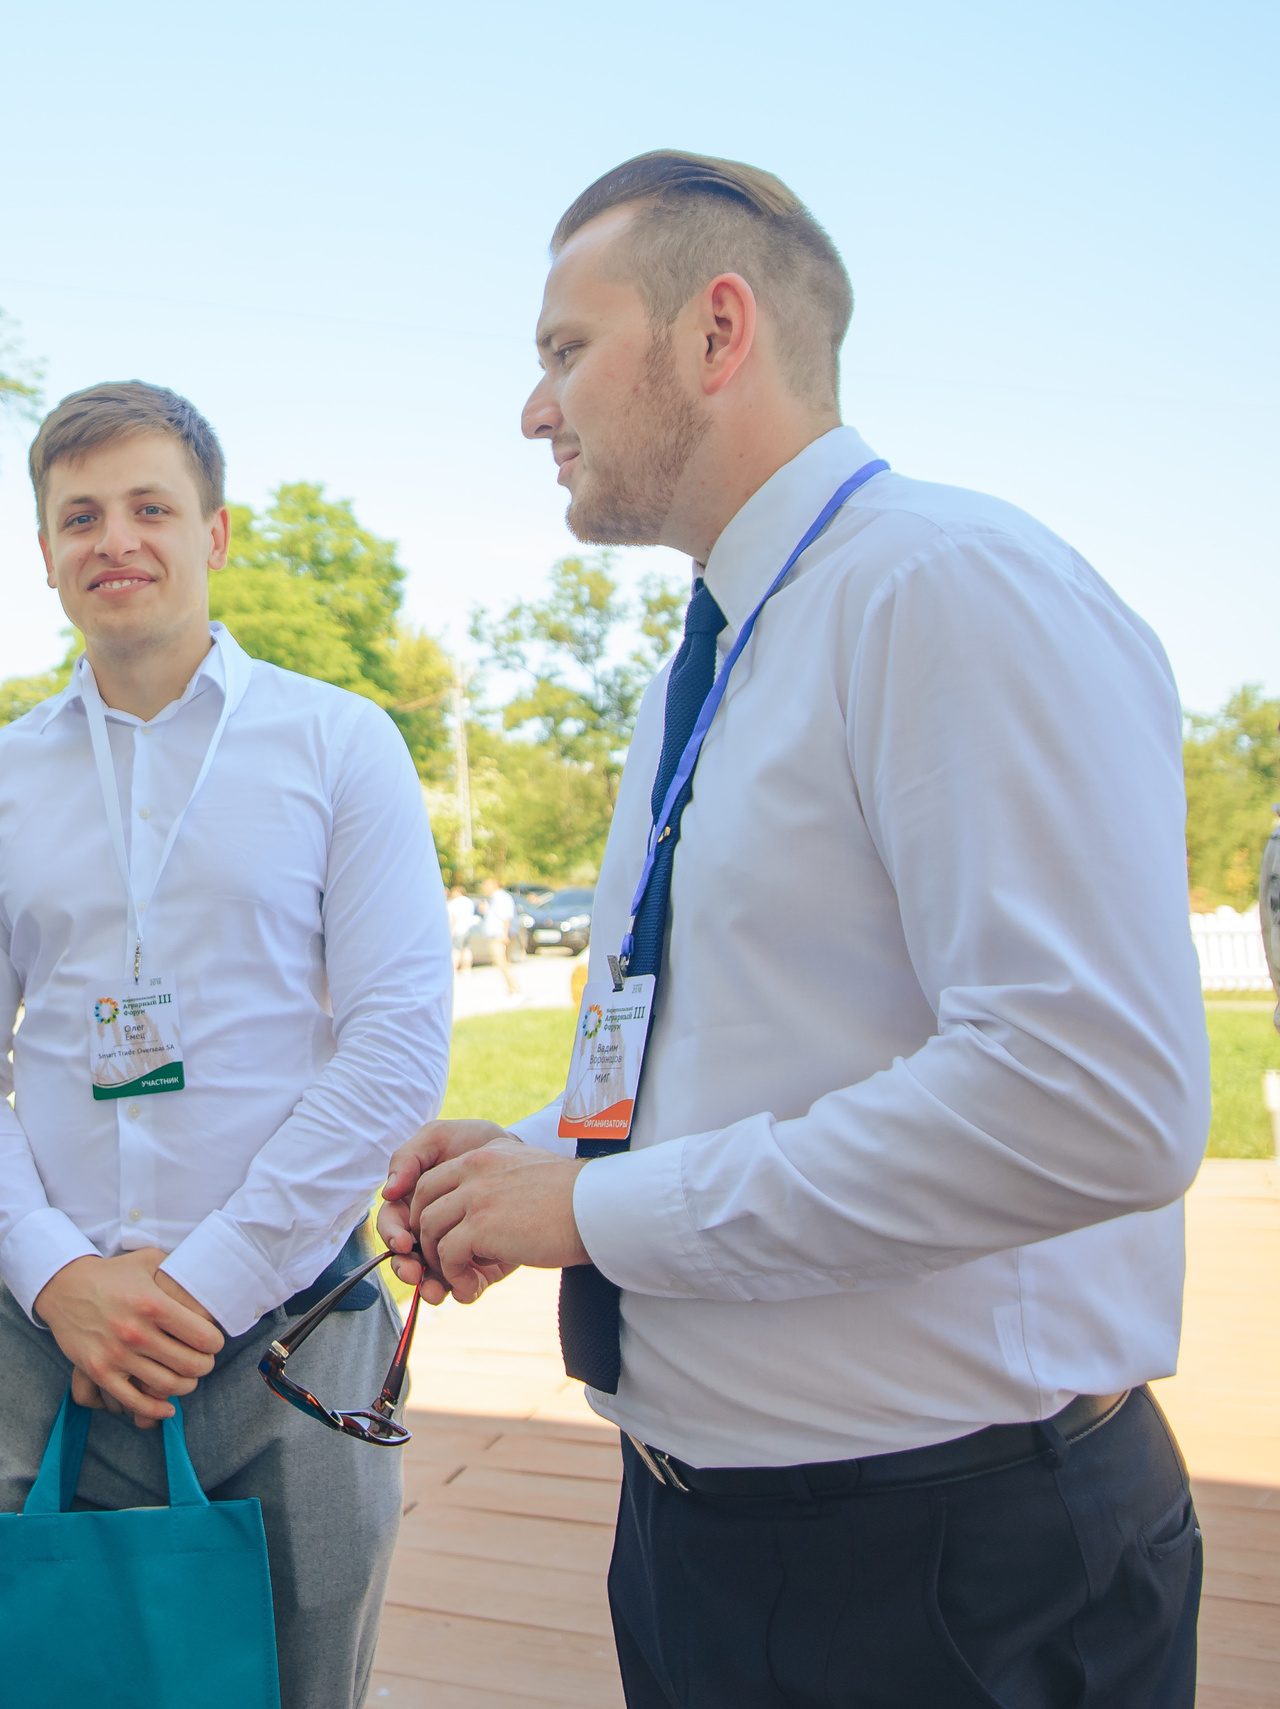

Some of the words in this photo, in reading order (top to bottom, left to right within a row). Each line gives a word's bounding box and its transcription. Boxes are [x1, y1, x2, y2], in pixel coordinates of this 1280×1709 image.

[158, 994, 172, 1004] III
[123, 1000, 157, 1010] Аграрный
[123, 1008, 146, 1017] Форум
[632, 1006, 646, 1020] III
[604, 1012, 633, 1024] Аграрный
[124, 1024, 145, 1033] Олег
[603, 1023, 622, 1032] Форум
[125, 1033, 146, 1041] Емец
[98, 1051, 117, 1060] Smart
[118, 1049, 136, 1057] Trade
[137, 1046, 165, 1054] Overseas
[166, 1043, 175, 1051] SA
[597, 1043, 619, 1054] Вадим
[589, 1054, 623, 1066] Воронцов
[141, 1076, 180, 1088] УЧАСТНИК
[594, 1073, 611, 1083] МИГ
[583, 1118, 629, 1129] ОРГАНИЗАТОРЫ
